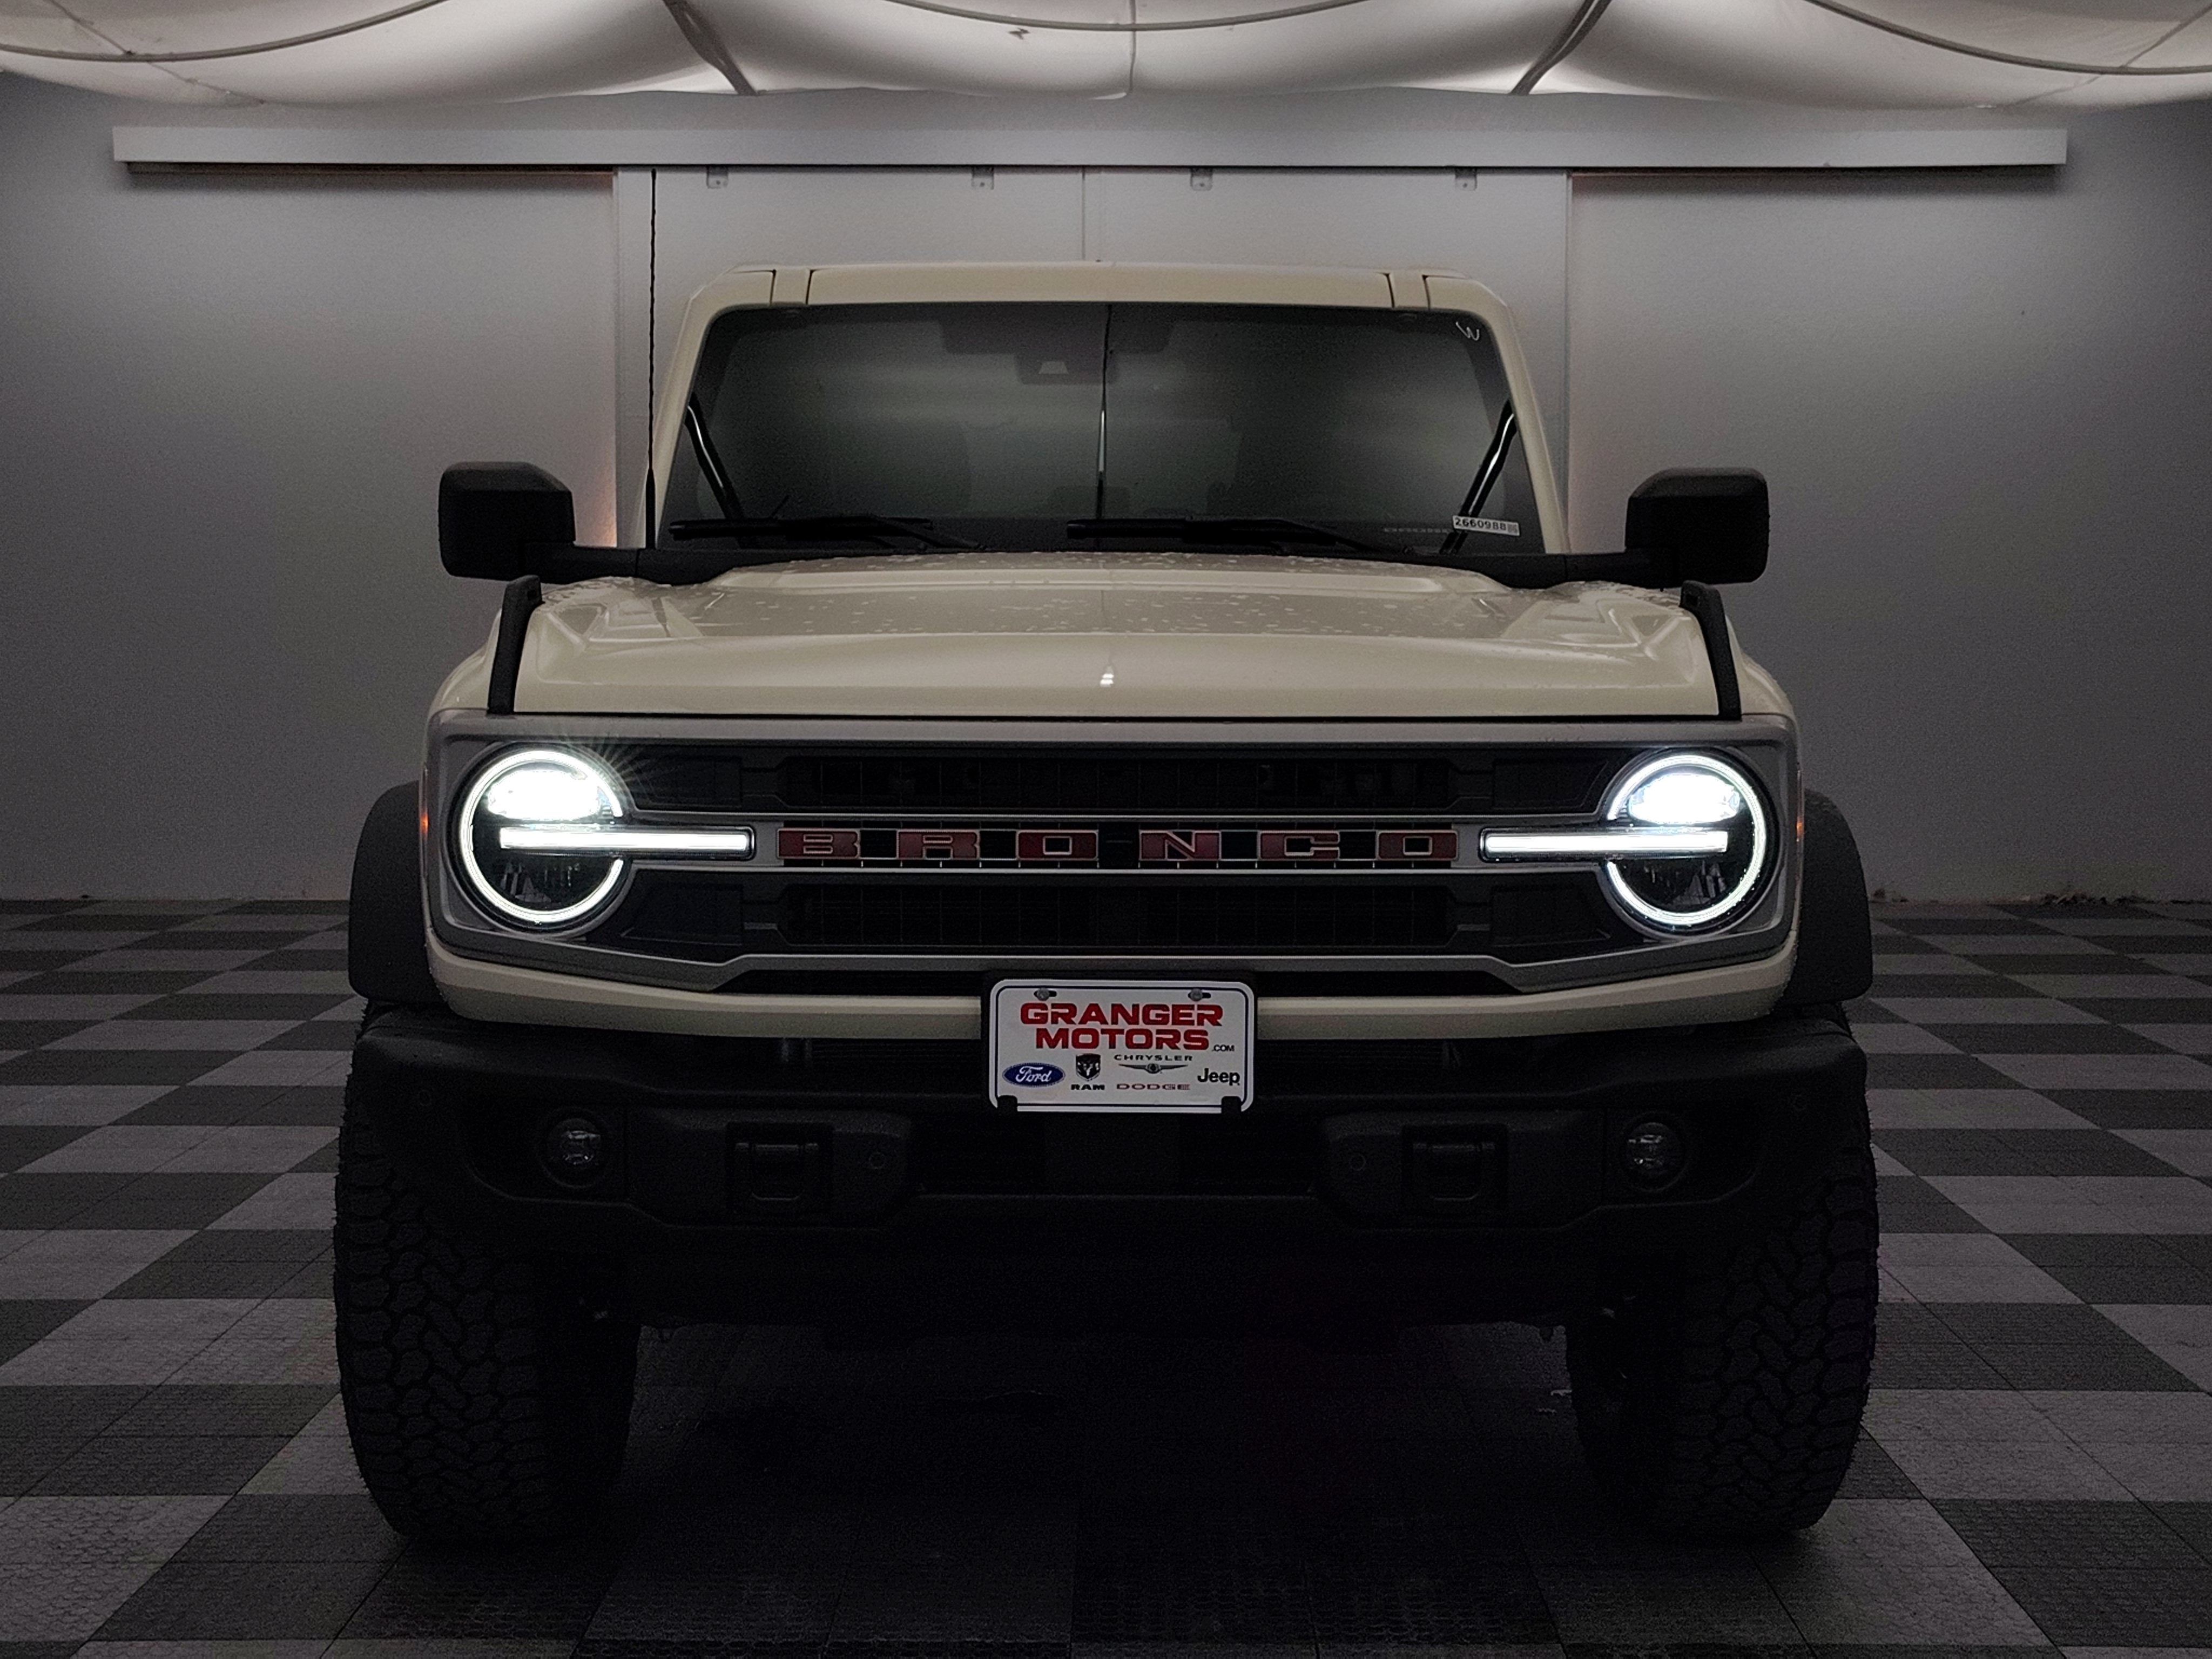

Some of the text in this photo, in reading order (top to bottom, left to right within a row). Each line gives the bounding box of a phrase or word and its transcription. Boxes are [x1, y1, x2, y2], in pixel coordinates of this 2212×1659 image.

[777, 828, 1460, 861] BRONCO
[1020, 1002, 1223, 1026] GRANGER
[1036, 1028, 1209, 1050] MOTORS
[1015, 1065, 1052, 1083] Ford
[1197, 1068, 1240, 1085] Jeep
